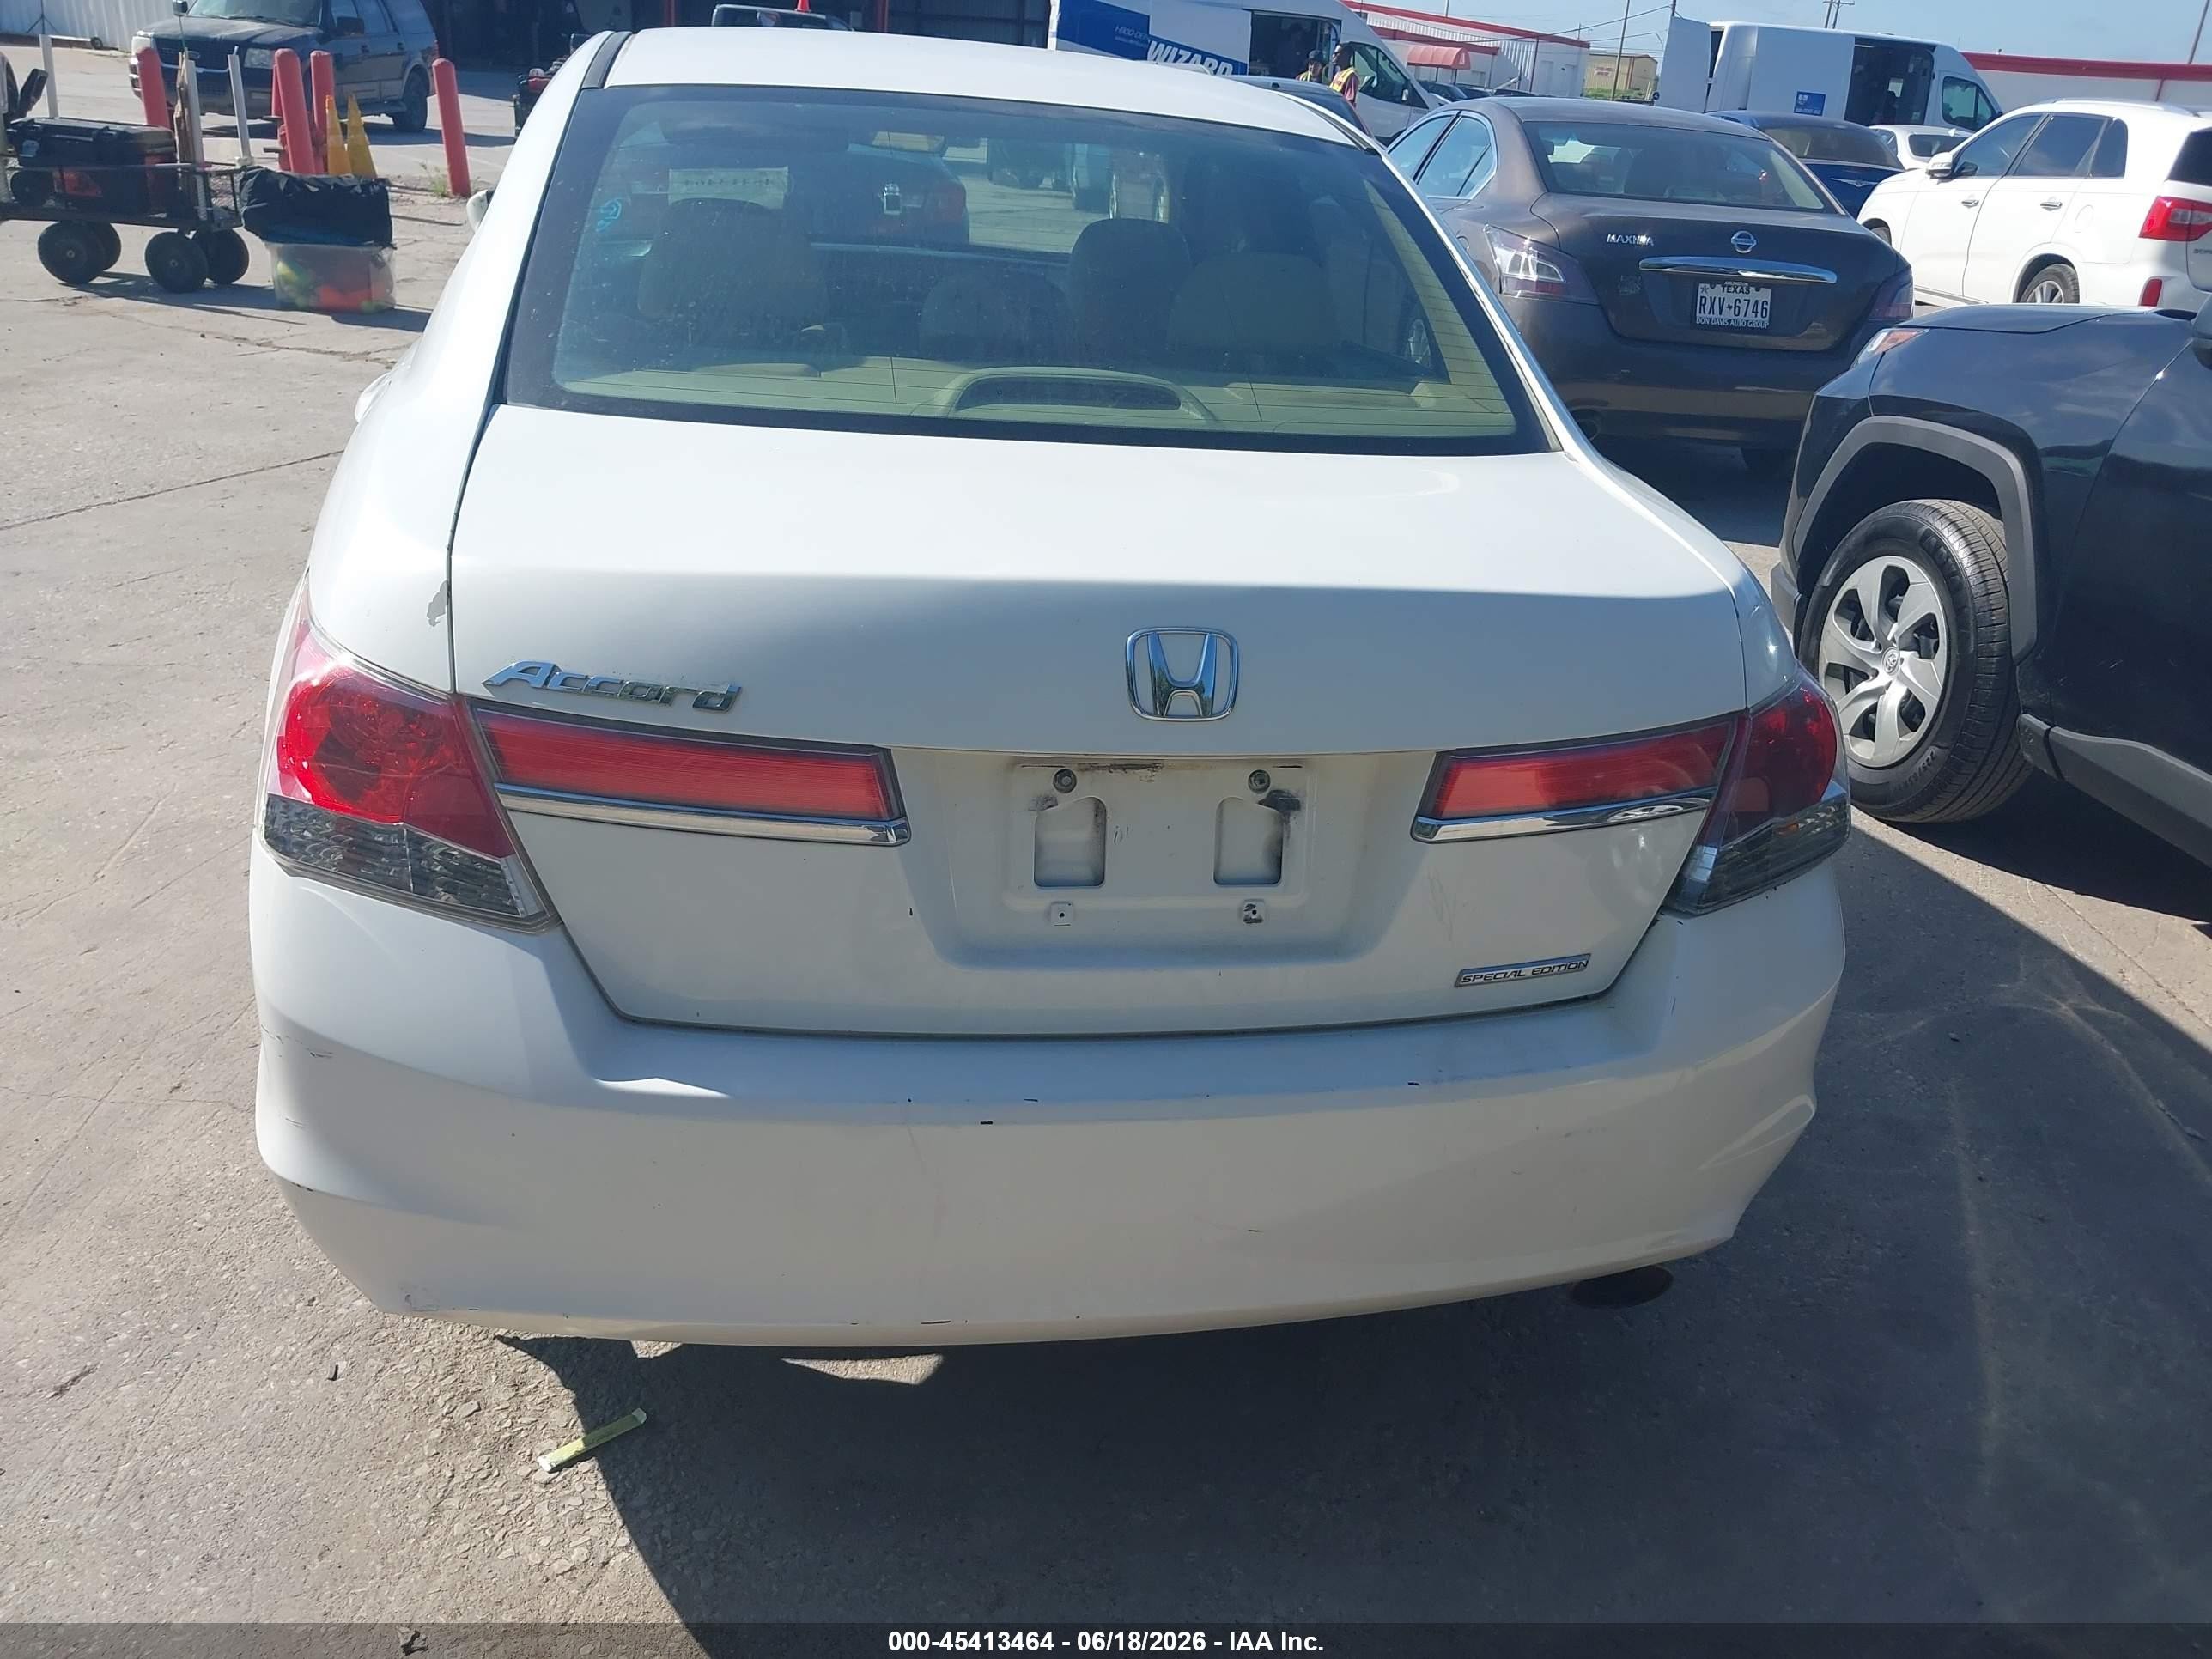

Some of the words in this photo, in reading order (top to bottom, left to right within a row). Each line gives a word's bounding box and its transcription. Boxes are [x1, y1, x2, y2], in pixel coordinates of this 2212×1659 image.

[1607, 234, 1654, 246] MAXIMA
[1722, 284, 1751, 295] TEXAS
[1696, 316, 1711, 325] DON
[1711, 317, 1729, 326] DAVIS
[1729, 319, 1747, 327] AUTO
[1747, 320, 1769, 329] GROUP
[482, 659, 742, 712] Accord
[1461, 969, 1526, 984] SPECIAL
[1531, 959, 1589, 975] EDITION
